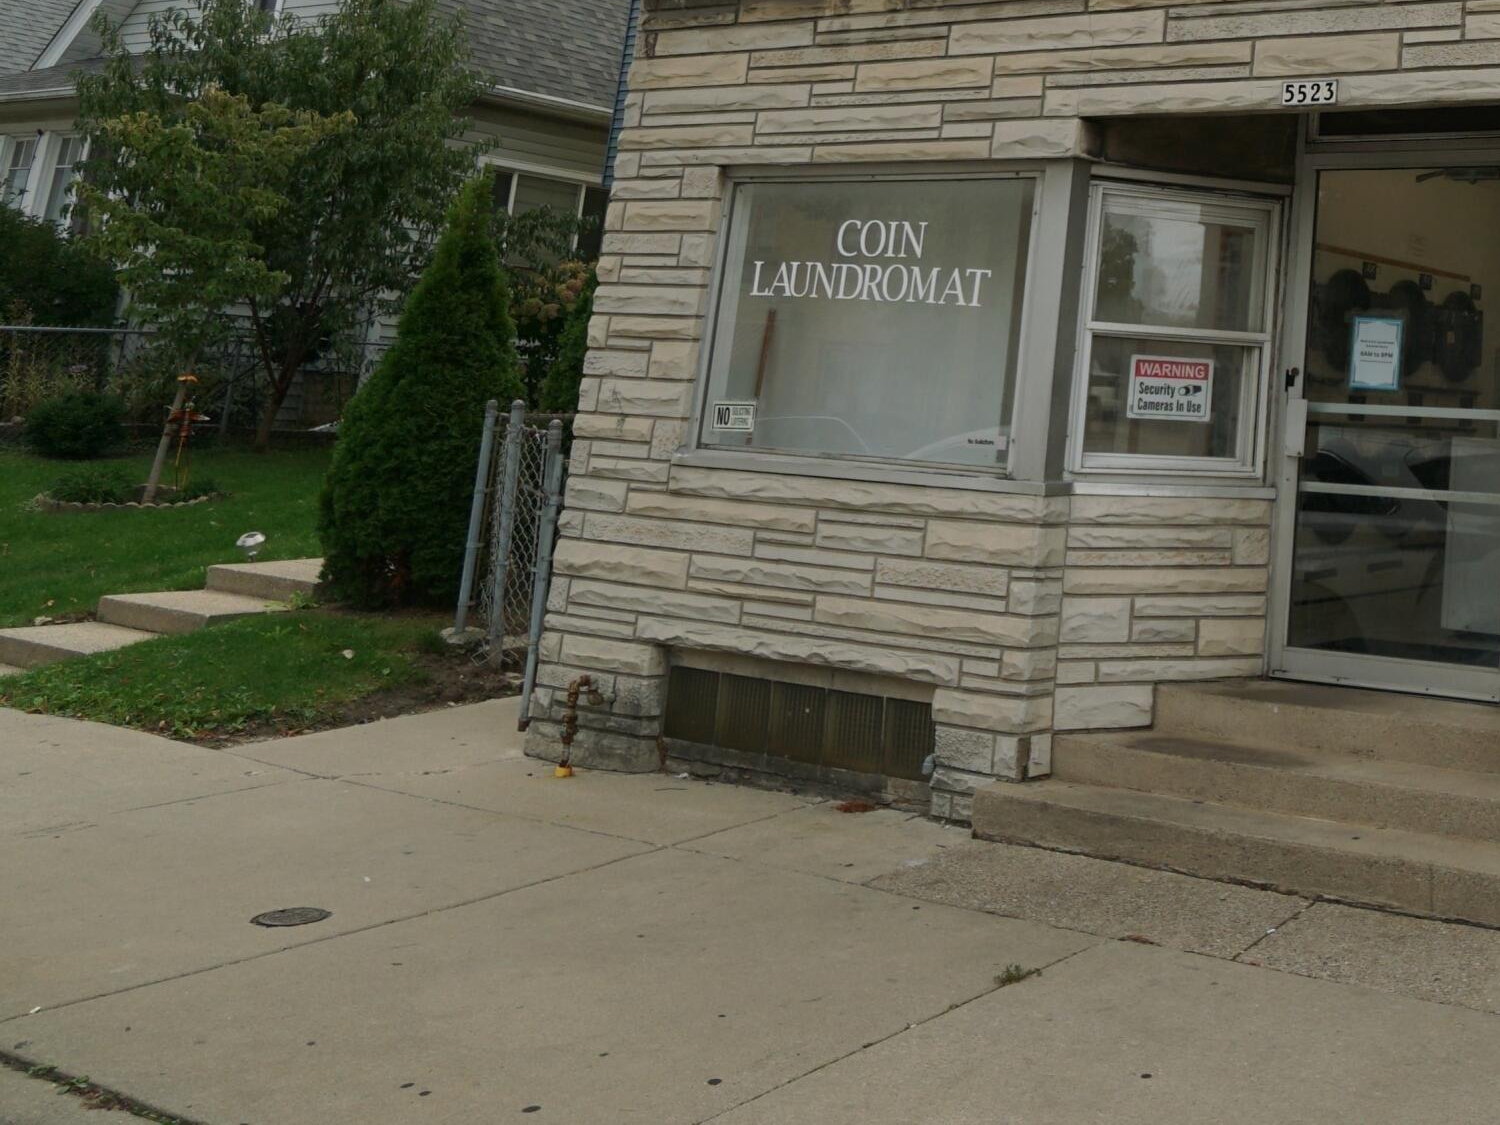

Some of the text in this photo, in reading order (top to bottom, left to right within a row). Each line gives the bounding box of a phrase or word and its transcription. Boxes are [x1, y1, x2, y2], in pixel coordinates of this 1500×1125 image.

[1284, 82, 1334, 103] 5523
[836, 219, 928, 259] COIN
[749, 260, 993, 307] LAUNDROMAT
[1140, 362, 1205, 378] WARNING
[1138, 381, 1176, 398] Security
[1137, 397, 1202, 413] Cameras In Use
[716, 406, 731, 426] NO
